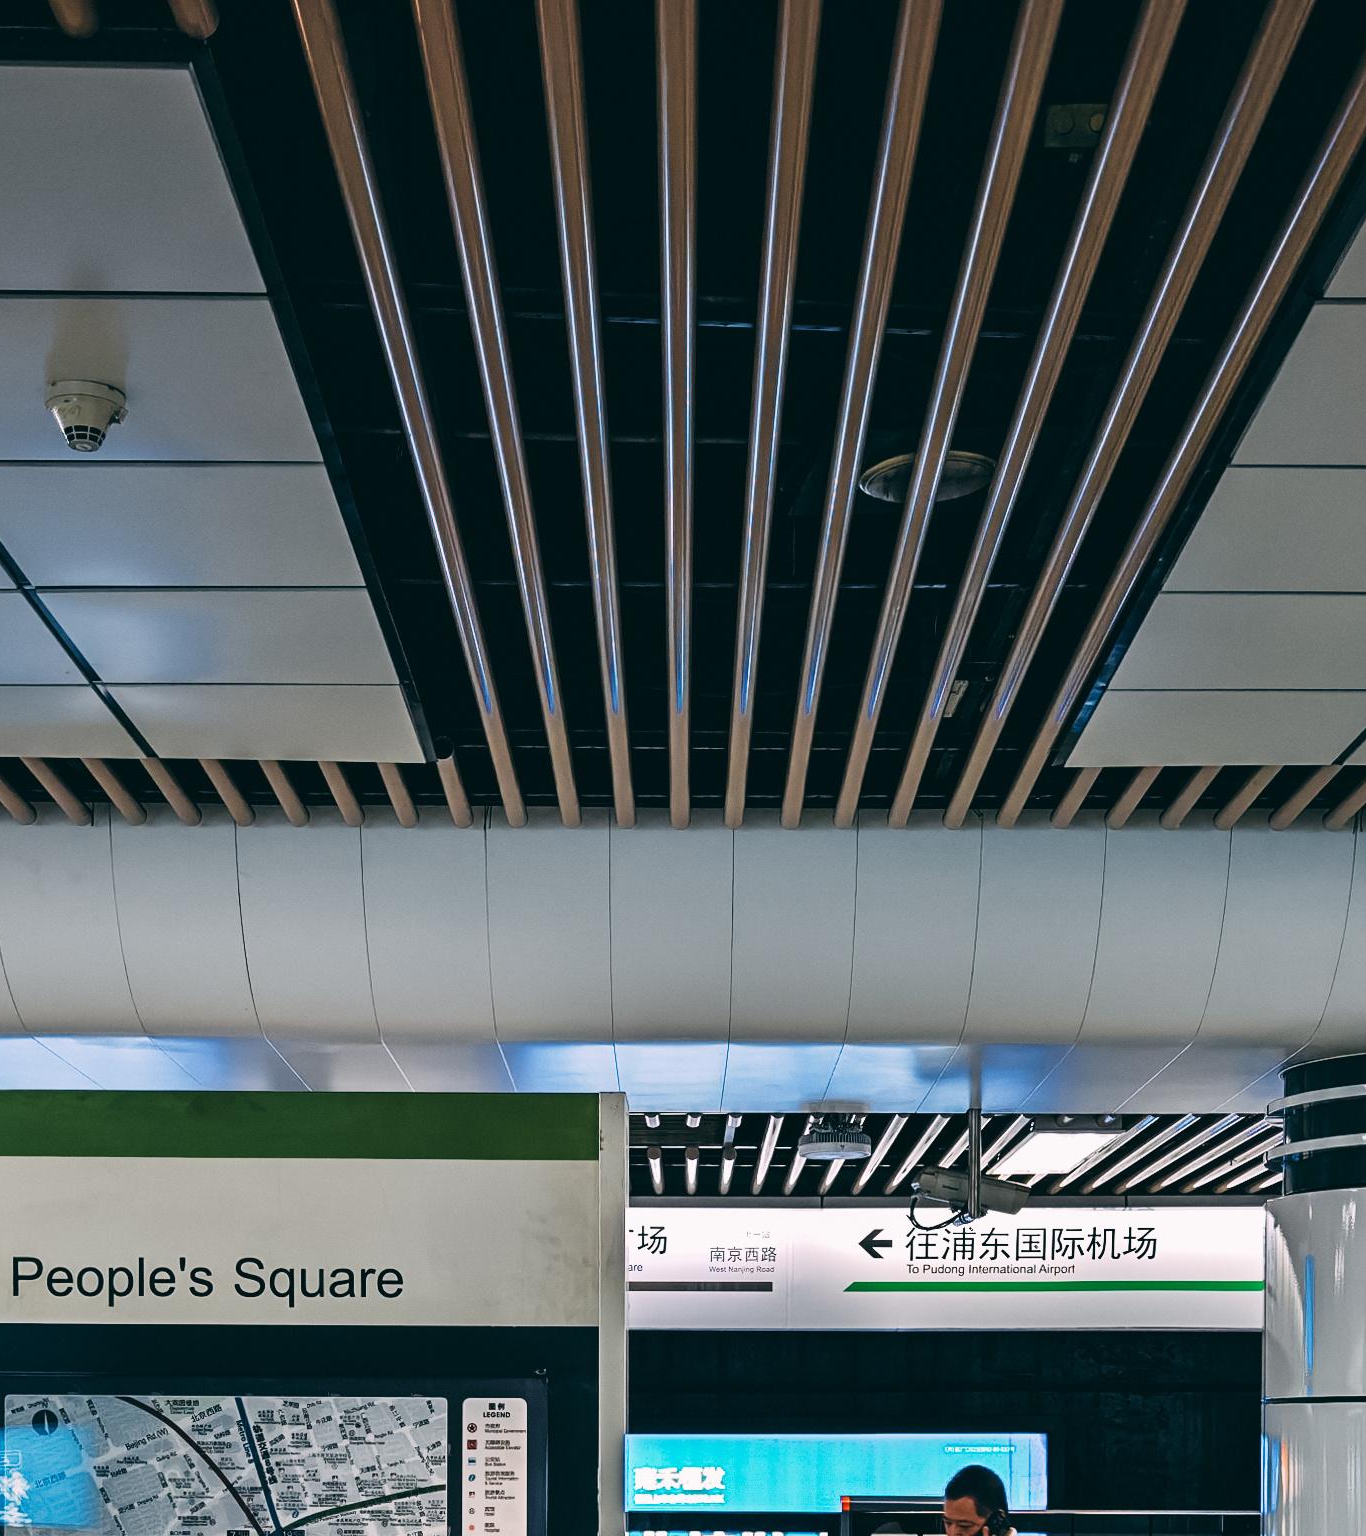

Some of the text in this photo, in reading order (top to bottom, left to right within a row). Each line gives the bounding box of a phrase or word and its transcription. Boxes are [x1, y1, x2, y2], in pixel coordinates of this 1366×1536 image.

[629, 1226, 667, 1254] 场
[906, 1227, 1157, 1261] 往浦东国际机场
[710, 1247, 777, 1262] 南京西路
[729, 1266, 754, 1274] Nanjing
[907, 1265, 1074, 1276] To Pudong International Airport
[13, 1255, 214, 1305] People's
[234, 1256, 403, 1303] Square
[191, 1404, 223, 1422] 北京西路
[125, 1437, 147, 1450] Beijing
